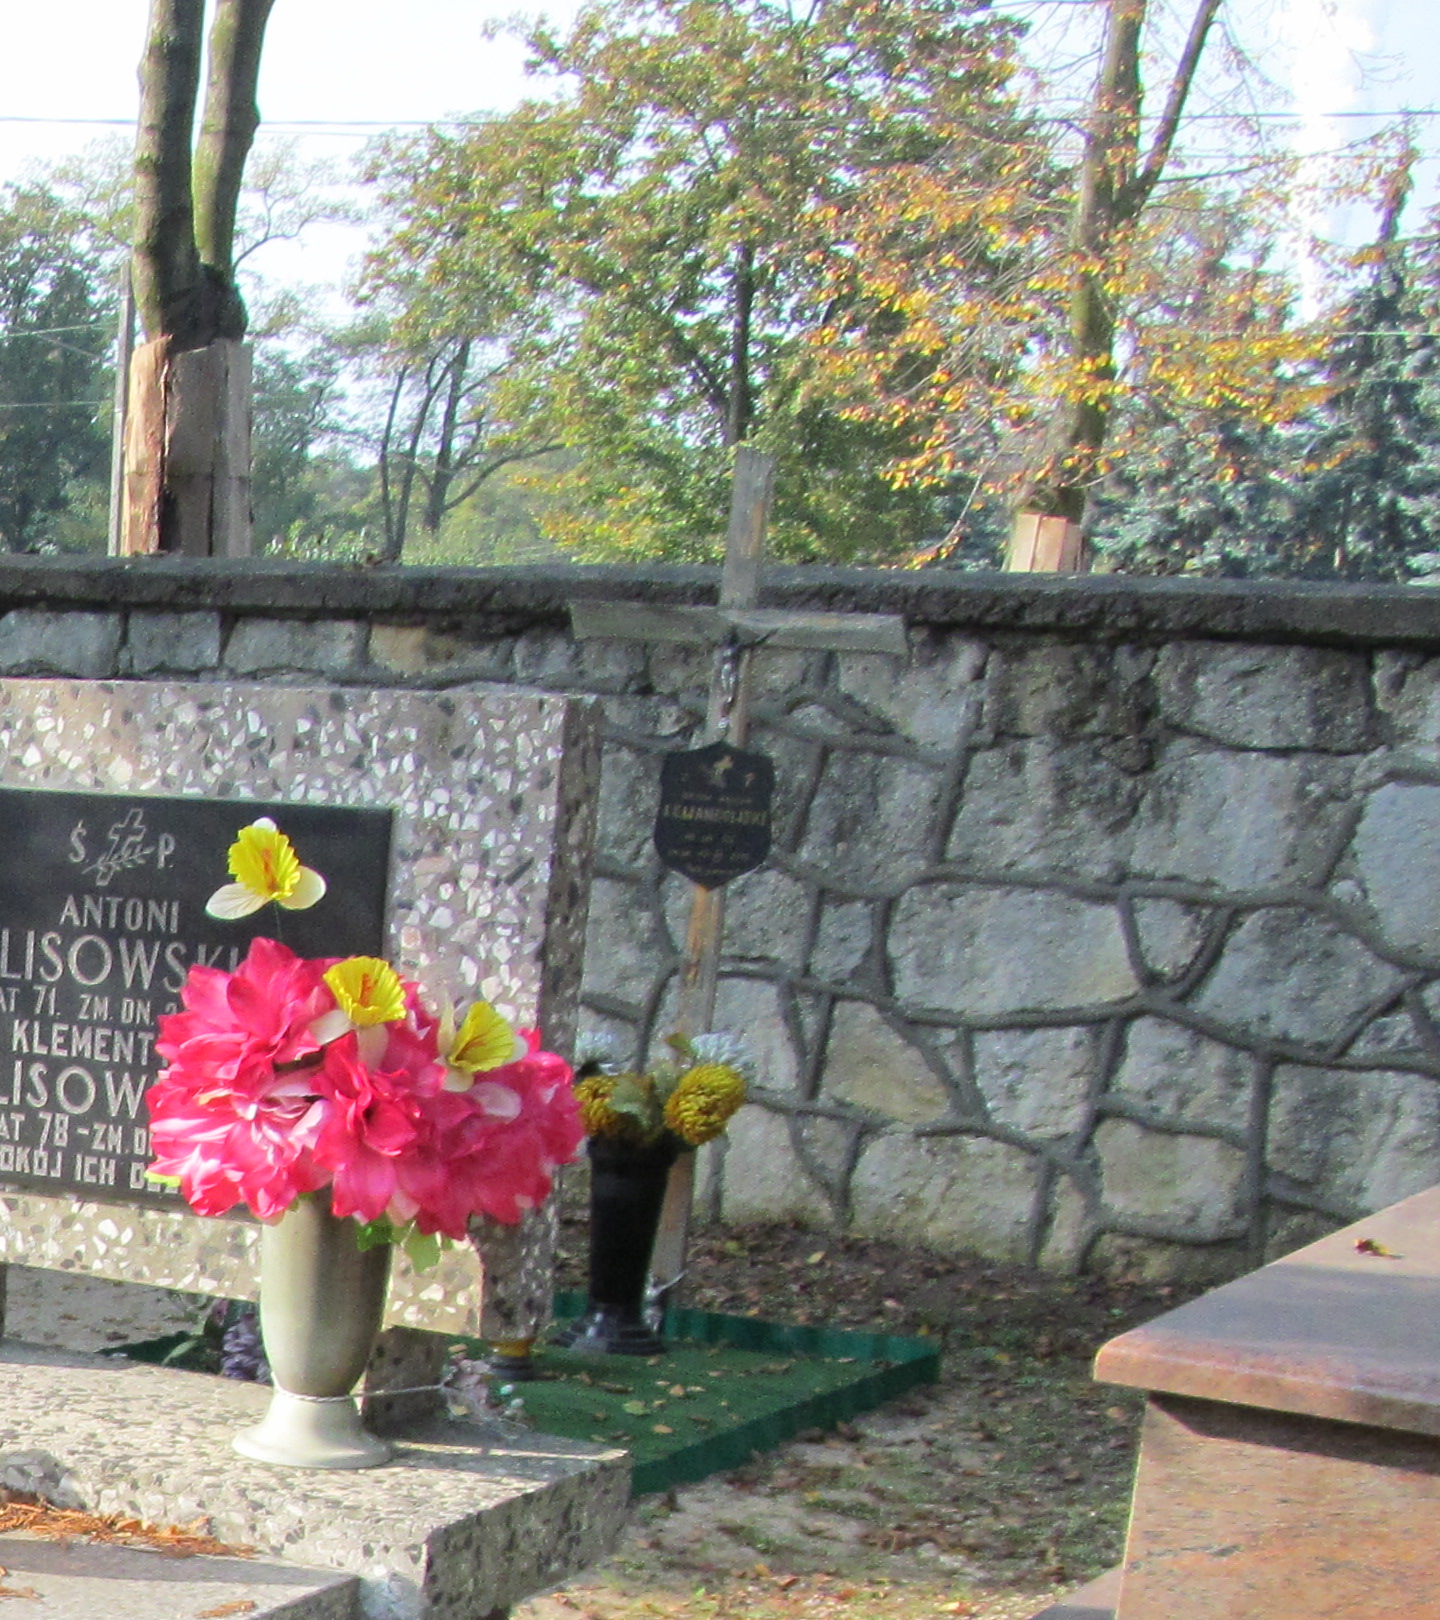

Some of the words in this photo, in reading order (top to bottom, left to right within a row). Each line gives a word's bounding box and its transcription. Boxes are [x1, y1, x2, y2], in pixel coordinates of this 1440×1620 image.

[60, 895, 180, 934] ANTONI
[33, 984, 61, 1017] 71.
[12, 1018, 169, 1067] KLEMENT
[38, 1110, 70, 1150] 78
[75, 1153, 117, 1186] ICH
